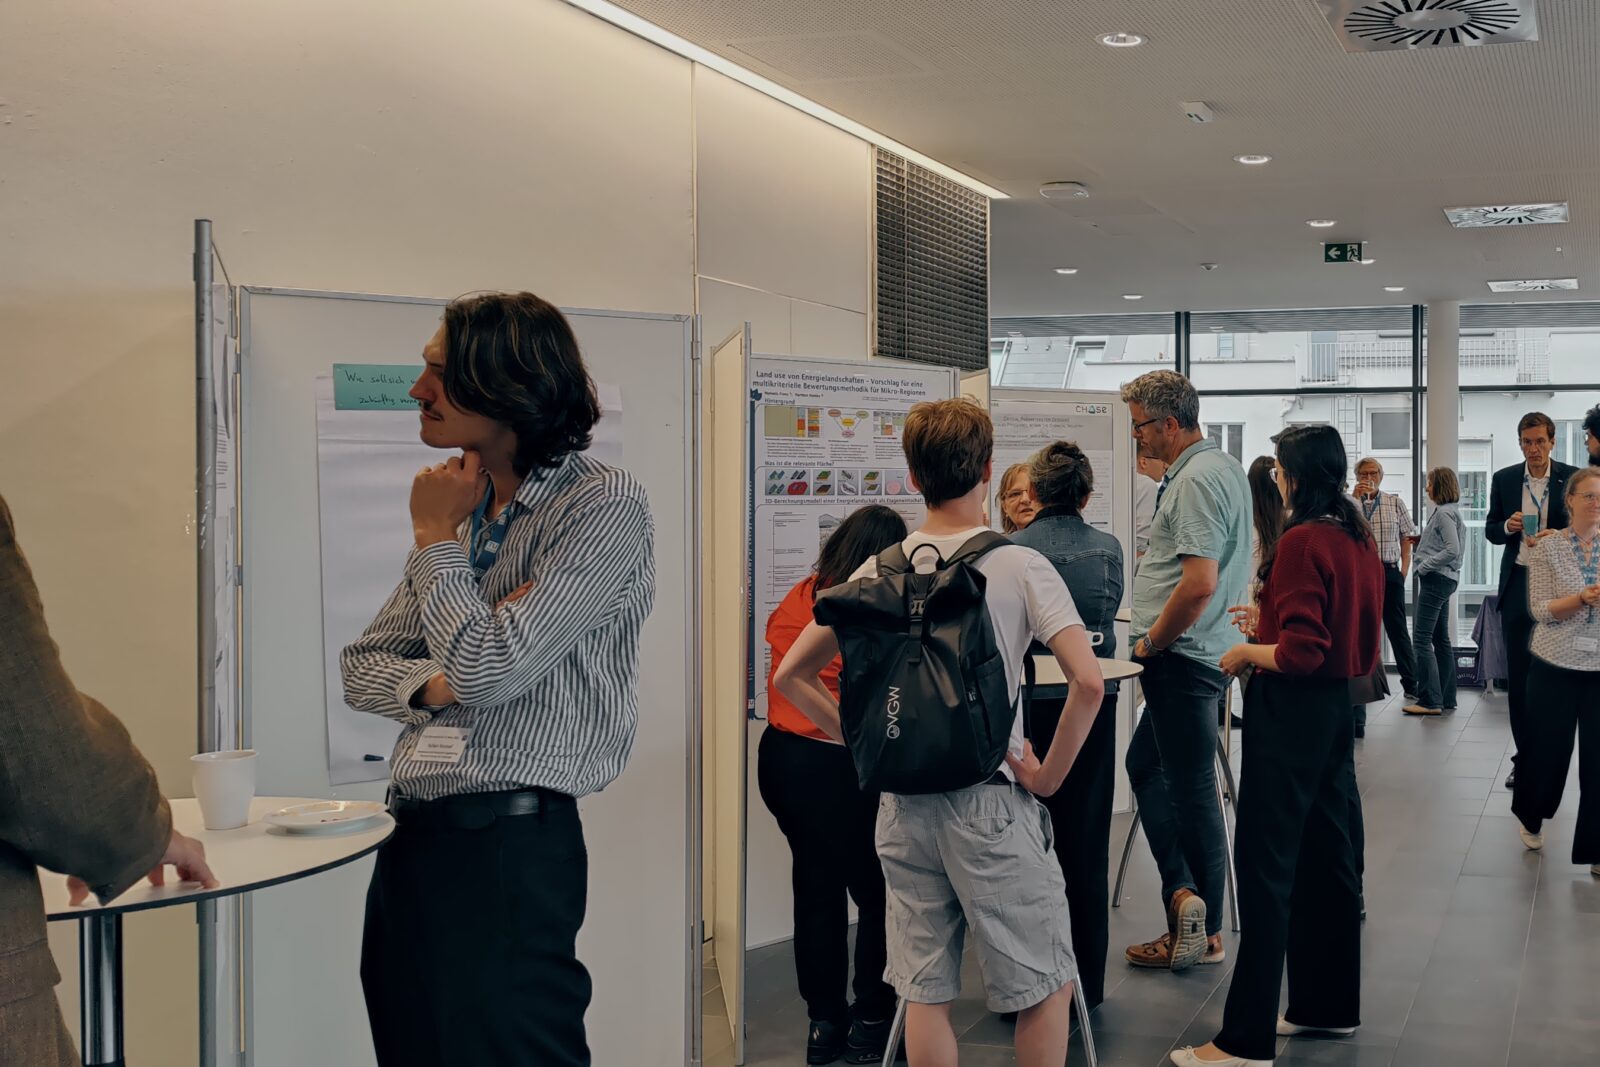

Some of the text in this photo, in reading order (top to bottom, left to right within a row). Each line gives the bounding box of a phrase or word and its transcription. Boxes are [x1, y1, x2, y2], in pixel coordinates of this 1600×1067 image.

[345, 370, 364, 382] Wie
[756, 370, 773, 379] Land
[801, 373, 865, 385] Energielandschaften
[870, 378, 899, 387] Vorschlag
[752, 379, 802, 389] multikriterielle
[803, 382, 868, 393] Bewertungsmethodik
[881, 386, 926, 396] Mikro-Regionen
